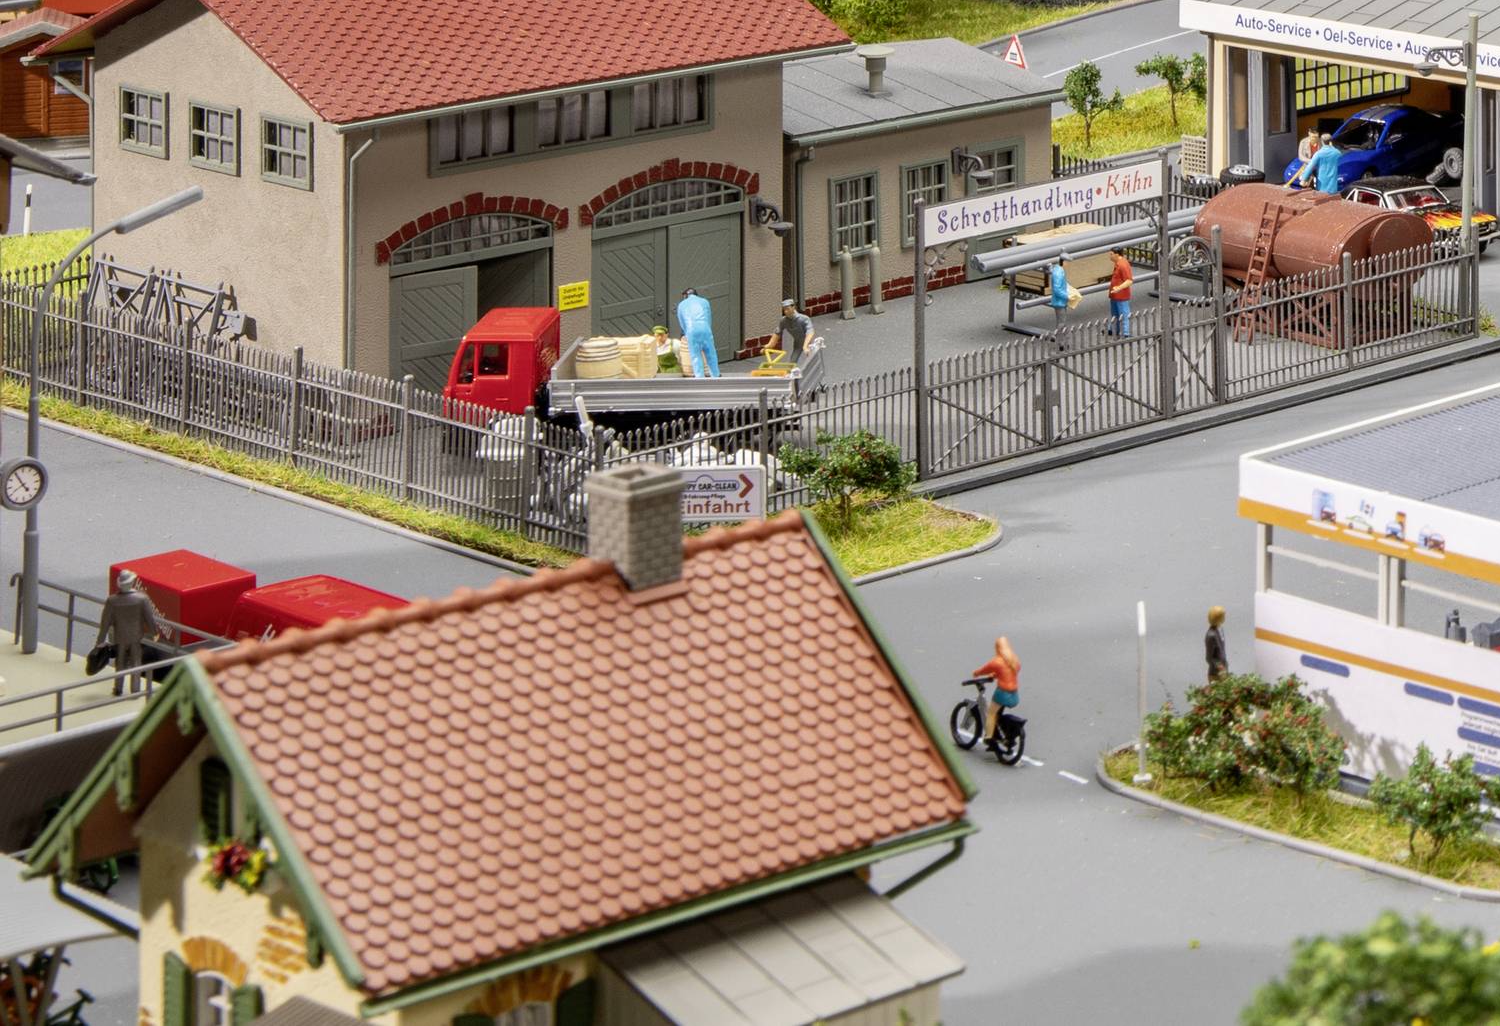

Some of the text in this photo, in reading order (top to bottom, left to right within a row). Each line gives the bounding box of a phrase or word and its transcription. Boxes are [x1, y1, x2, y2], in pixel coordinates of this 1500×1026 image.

[1235, 13, 1312, 38] Auto-Service
[1323, 27, 1393, 51] Oel-Service
[937, 170, 1153, 234] Schrotthandlung Kühn
